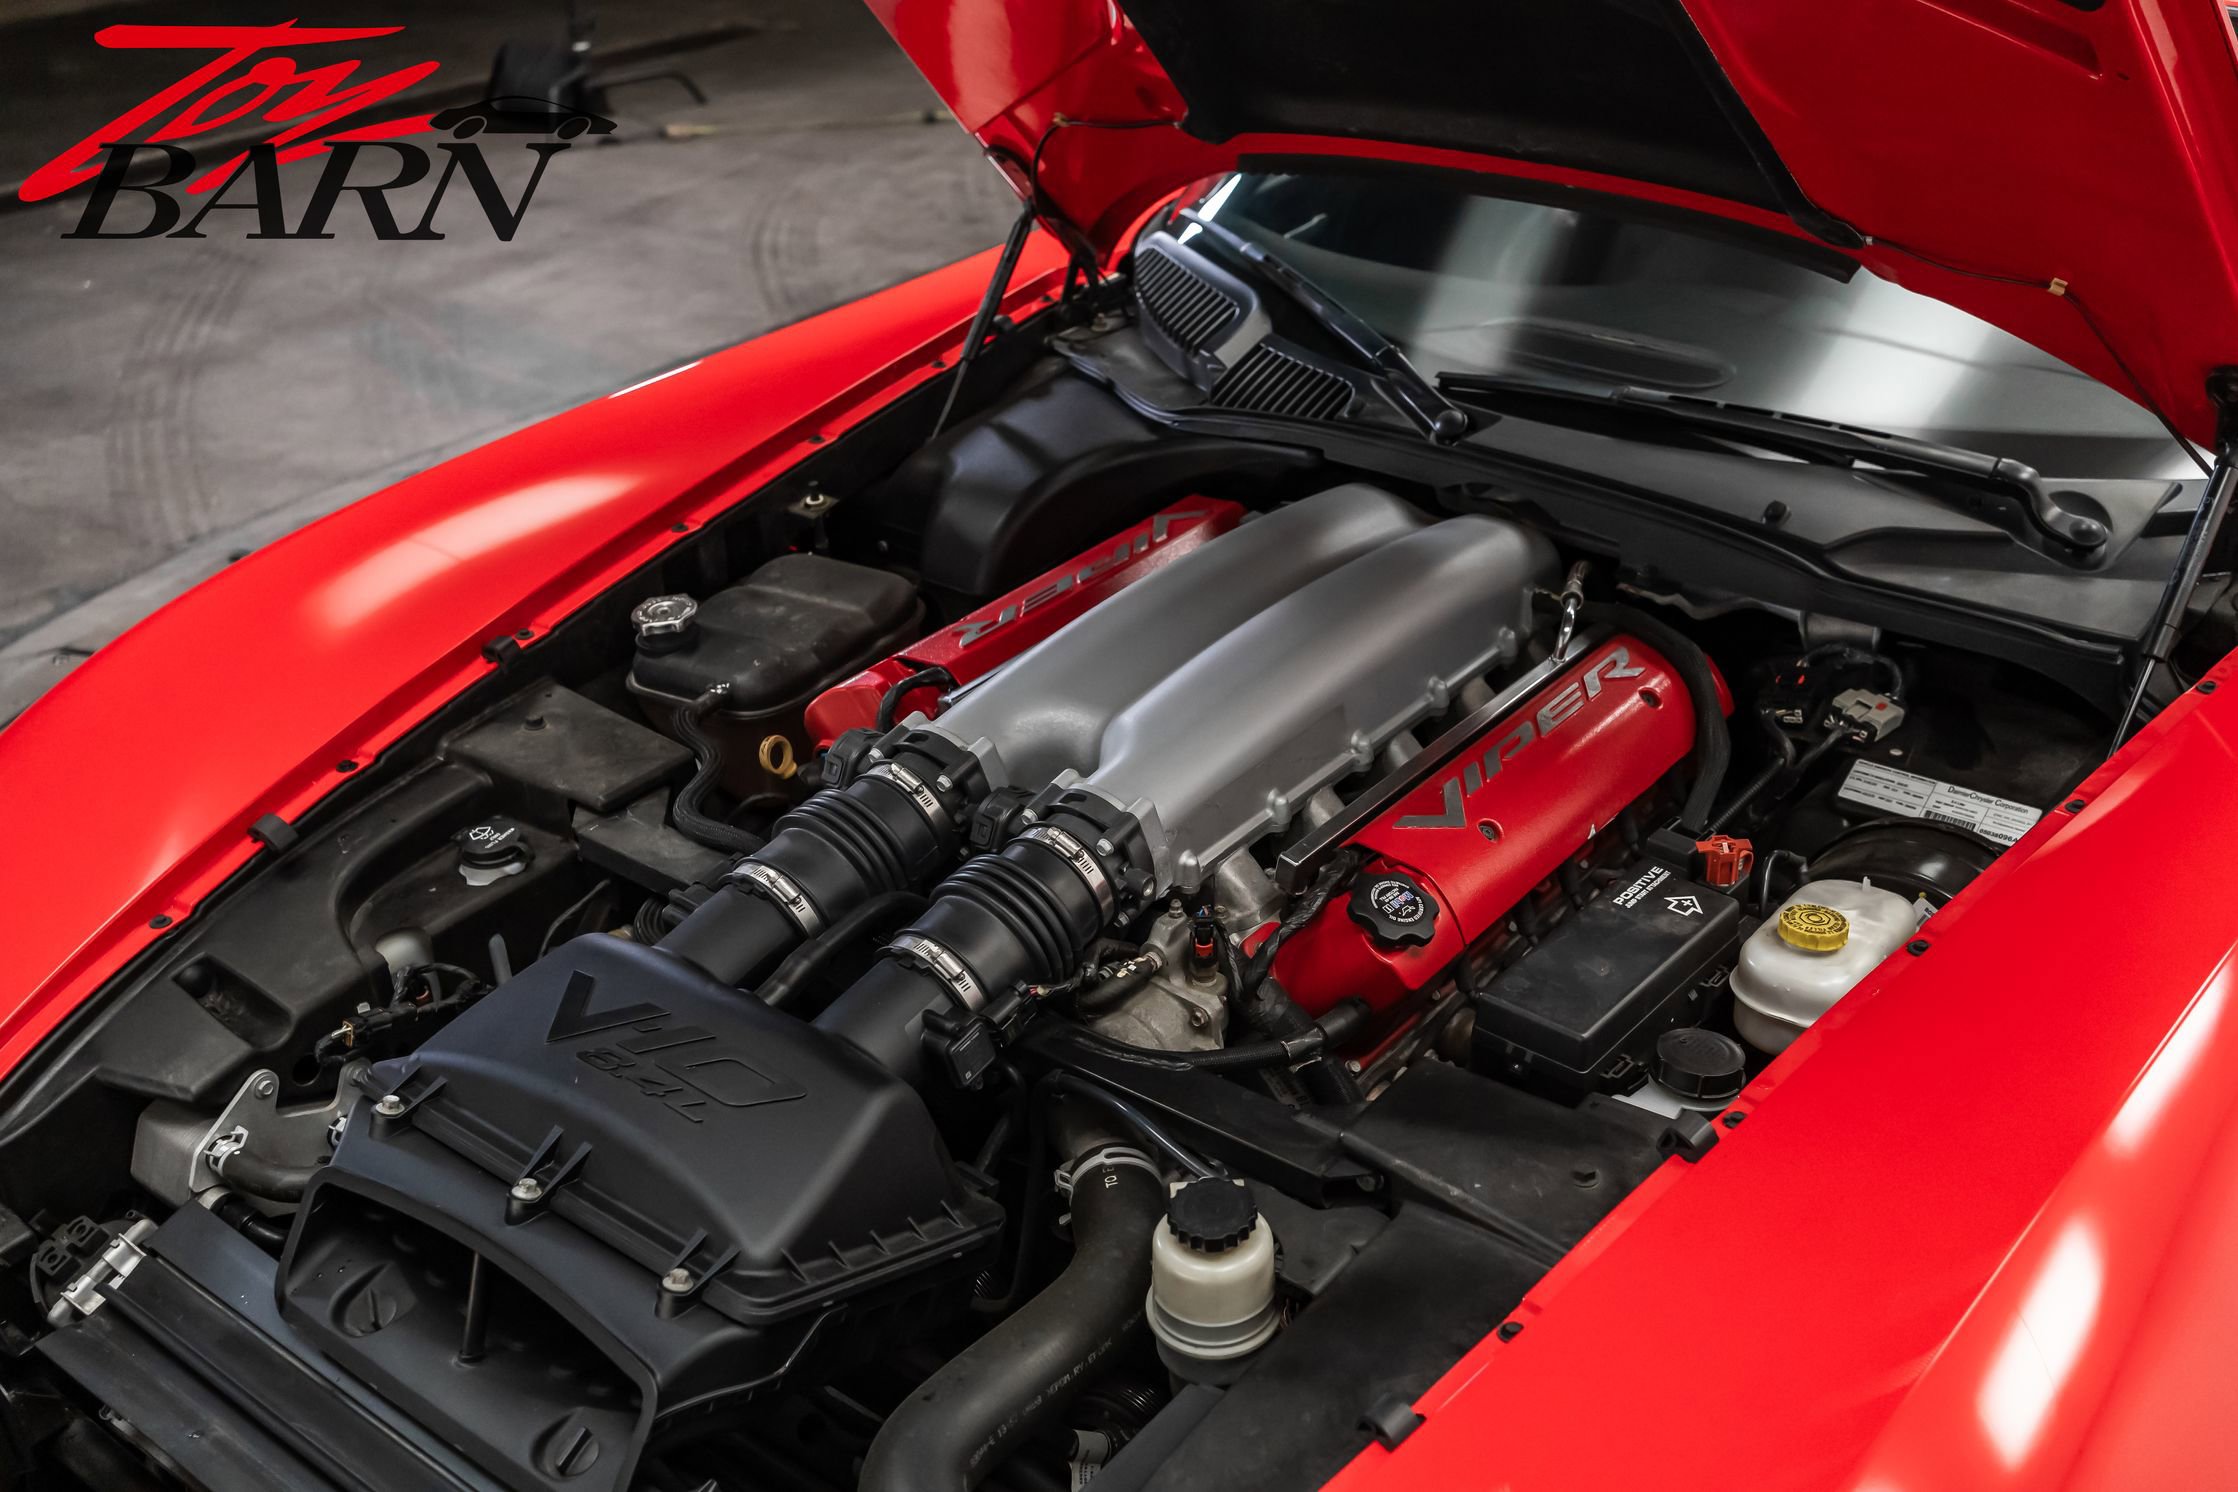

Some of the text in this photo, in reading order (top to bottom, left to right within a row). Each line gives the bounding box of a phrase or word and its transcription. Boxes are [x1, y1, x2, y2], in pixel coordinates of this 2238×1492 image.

[952, 510, 1209, 649] VIPER
[1392, 646, 1647, 829] VIPER
[1994, 799, 2029, 814] Corporation
[1612, 866, 1664, 905] POSITIVE
[544, 969, 808, 1107] V10
[576, 1048, 707, 1123] 8.4L
[1104, 1175, 1119, 1189] TO
